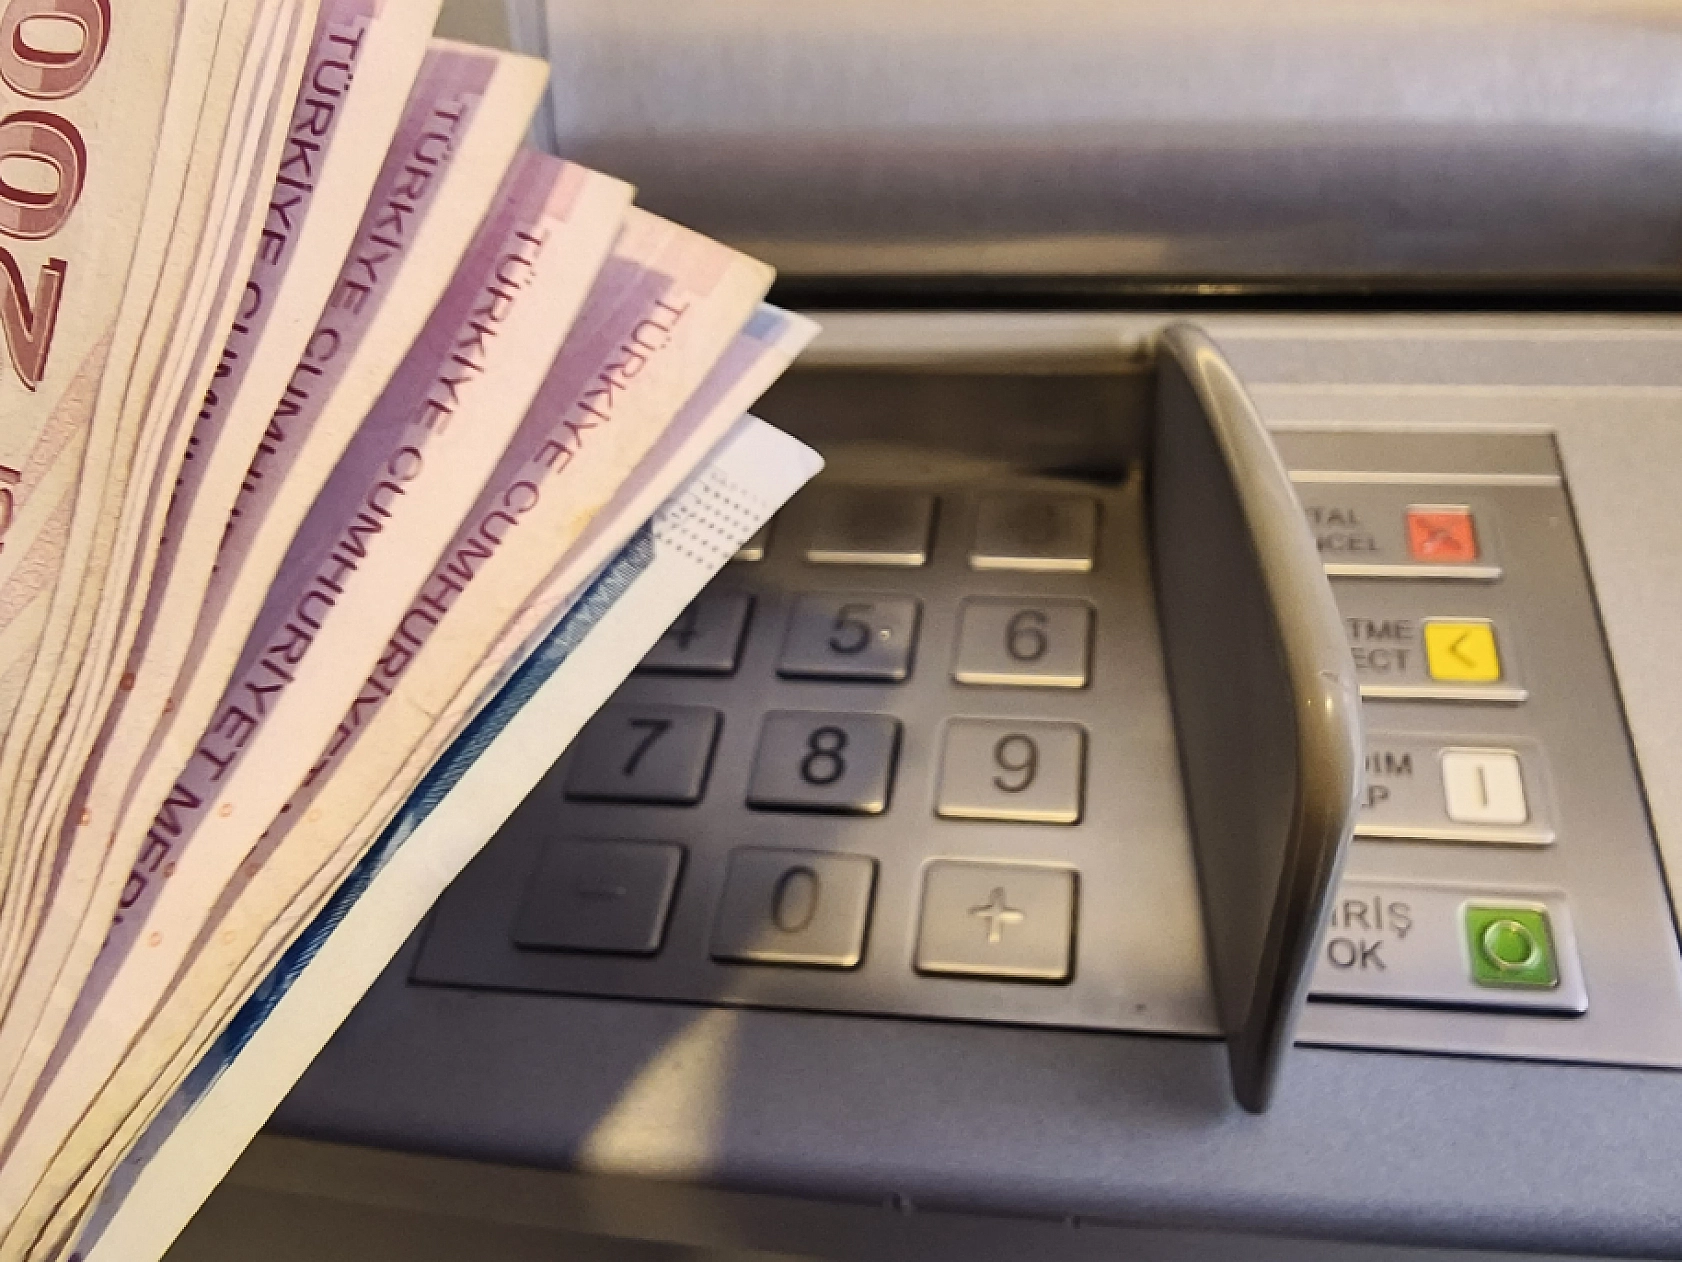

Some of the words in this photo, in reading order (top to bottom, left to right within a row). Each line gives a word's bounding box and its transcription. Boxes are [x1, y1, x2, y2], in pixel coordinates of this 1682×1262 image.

[1304, 506, 1358, 526] TAL
[828, 603, 874, 655] 5
[1005, 609, 1048, 662] 6
[622, 719, 673, 778] 7
[800, 726, 848, 785] 8
[992, 733, 1039, 793] 9
[771, 865, 820, 933] 0
[1327, 937, 1387, 969] OK
